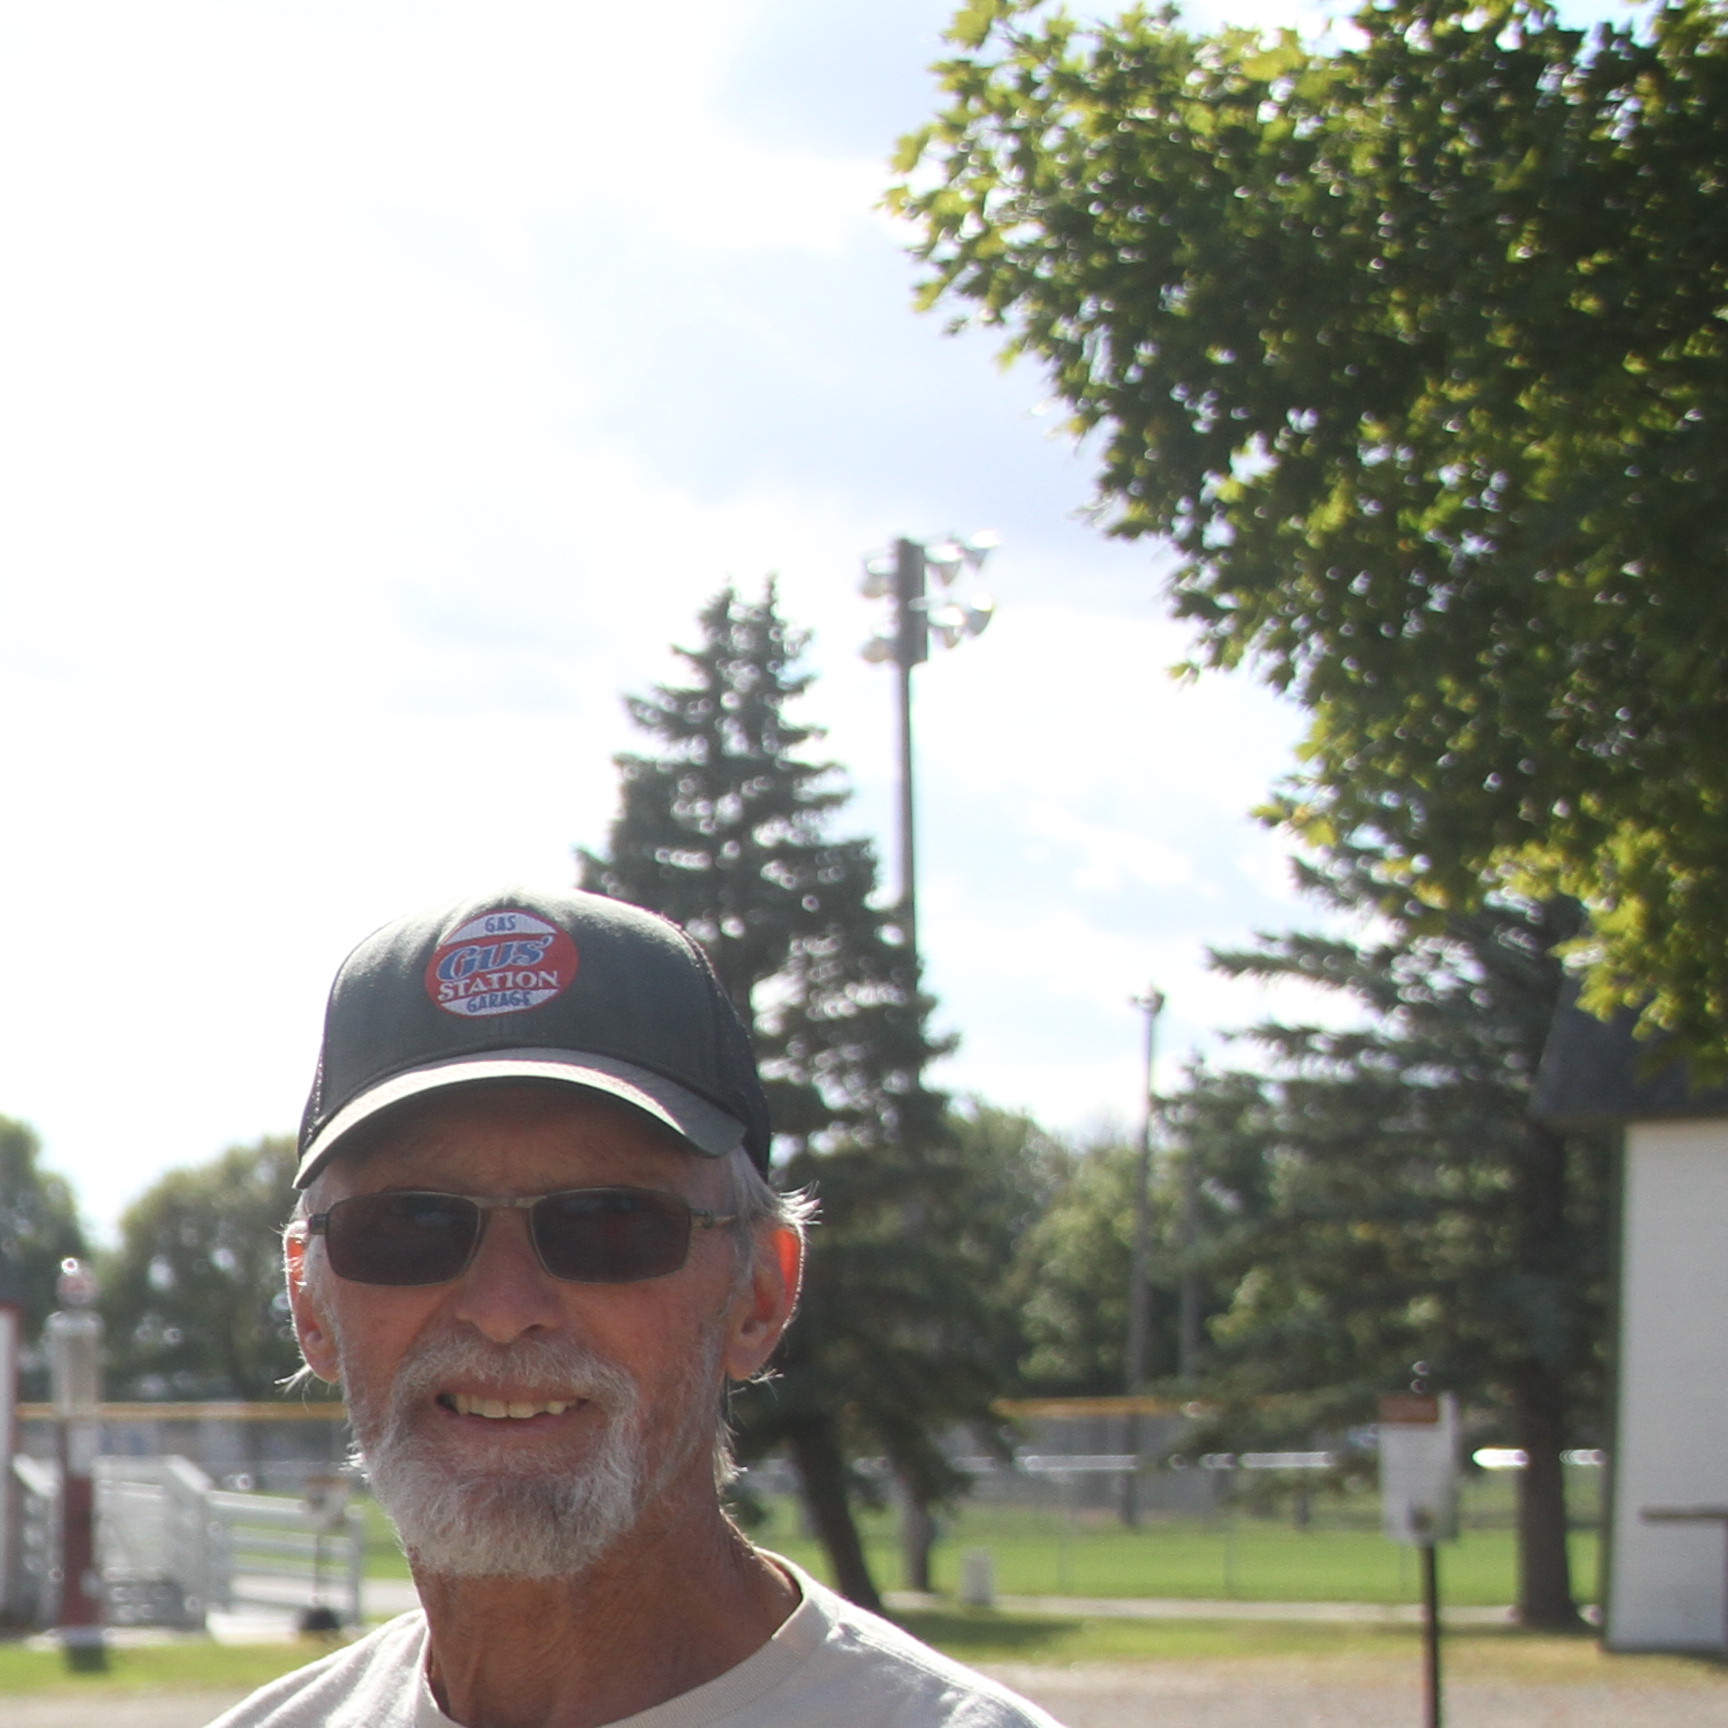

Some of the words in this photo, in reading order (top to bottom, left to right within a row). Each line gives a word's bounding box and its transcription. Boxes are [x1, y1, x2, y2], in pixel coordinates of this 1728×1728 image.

[485, 915, 517, 932] GAS
[438, 970, 560, 1001] STATION
[466, 990, 532, 1013] GARAGE
